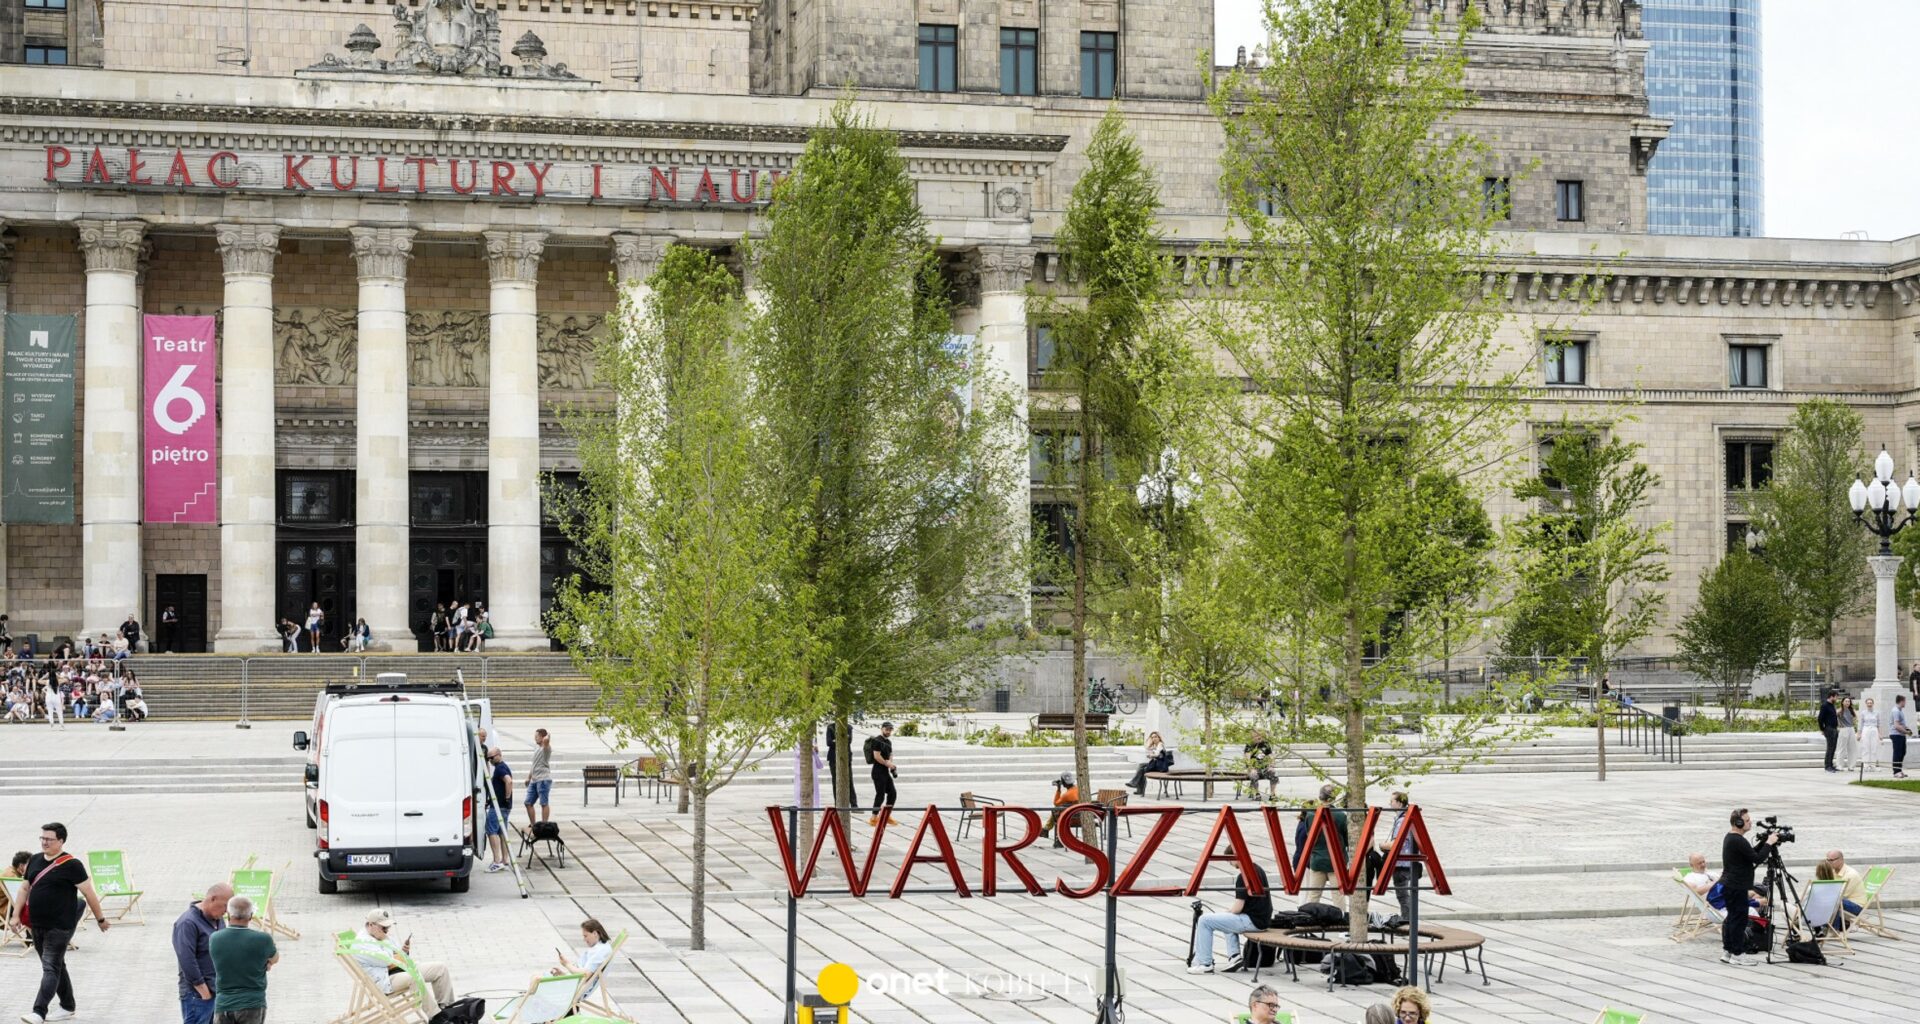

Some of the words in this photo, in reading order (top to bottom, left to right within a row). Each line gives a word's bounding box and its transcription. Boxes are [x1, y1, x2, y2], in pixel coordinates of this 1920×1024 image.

[43, 145, 239, 189] PAŁAC
[283, 154, 554, 197] KULTURY
[592, 163, 604, 199] I
[648, 165, 791, 204] NAU
[152, 336, 207, 353] Teatr
[153, 364, 206, 435] 6
[152, 445, 209, 465] piętro
[765, 803, 1452, 899] WARSZAWA
